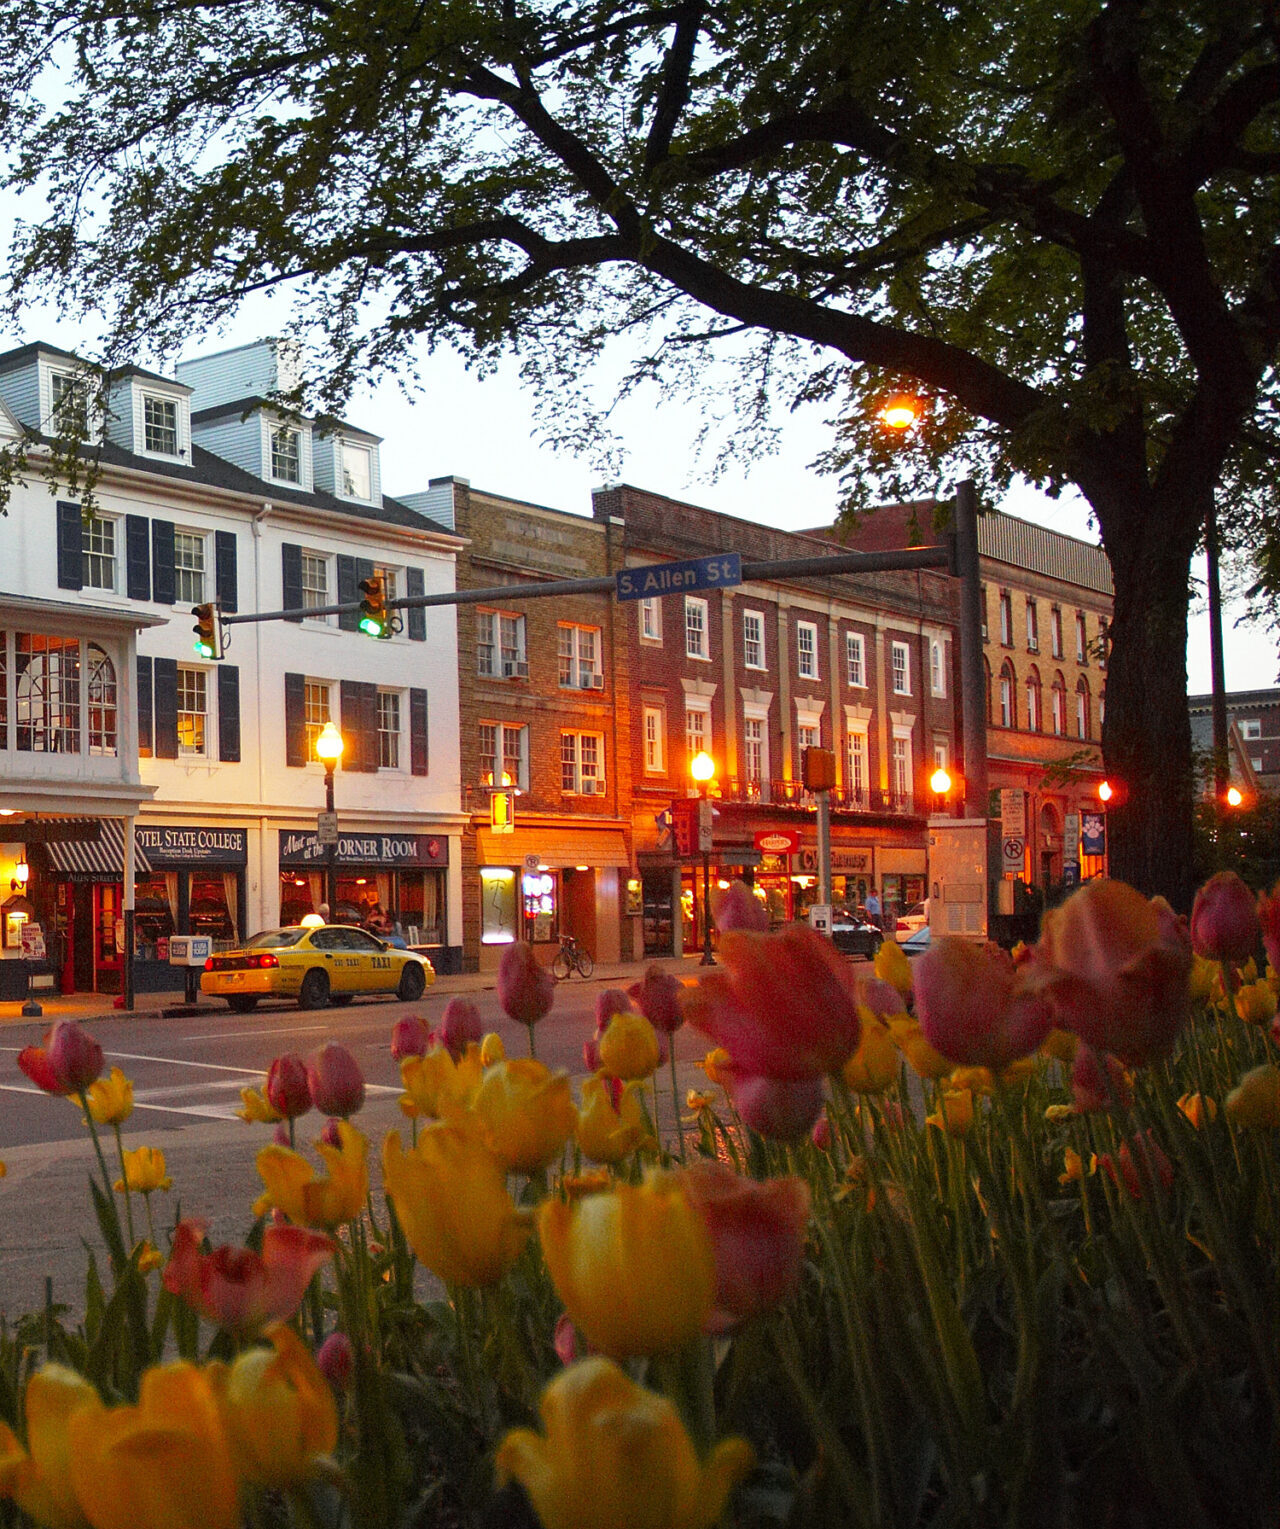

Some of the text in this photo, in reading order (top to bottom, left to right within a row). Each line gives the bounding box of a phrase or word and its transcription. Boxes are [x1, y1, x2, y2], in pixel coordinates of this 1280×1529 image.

[620, 561, 737, 594] S. Allen St.
[136, 830, 242, 851] OTEL STATE COLLEGE
[334, 837, 418, 858] ORNER ROOM
[346, 958, 360, 967] TAXI
[371, 956, 391, 969] TAXI
